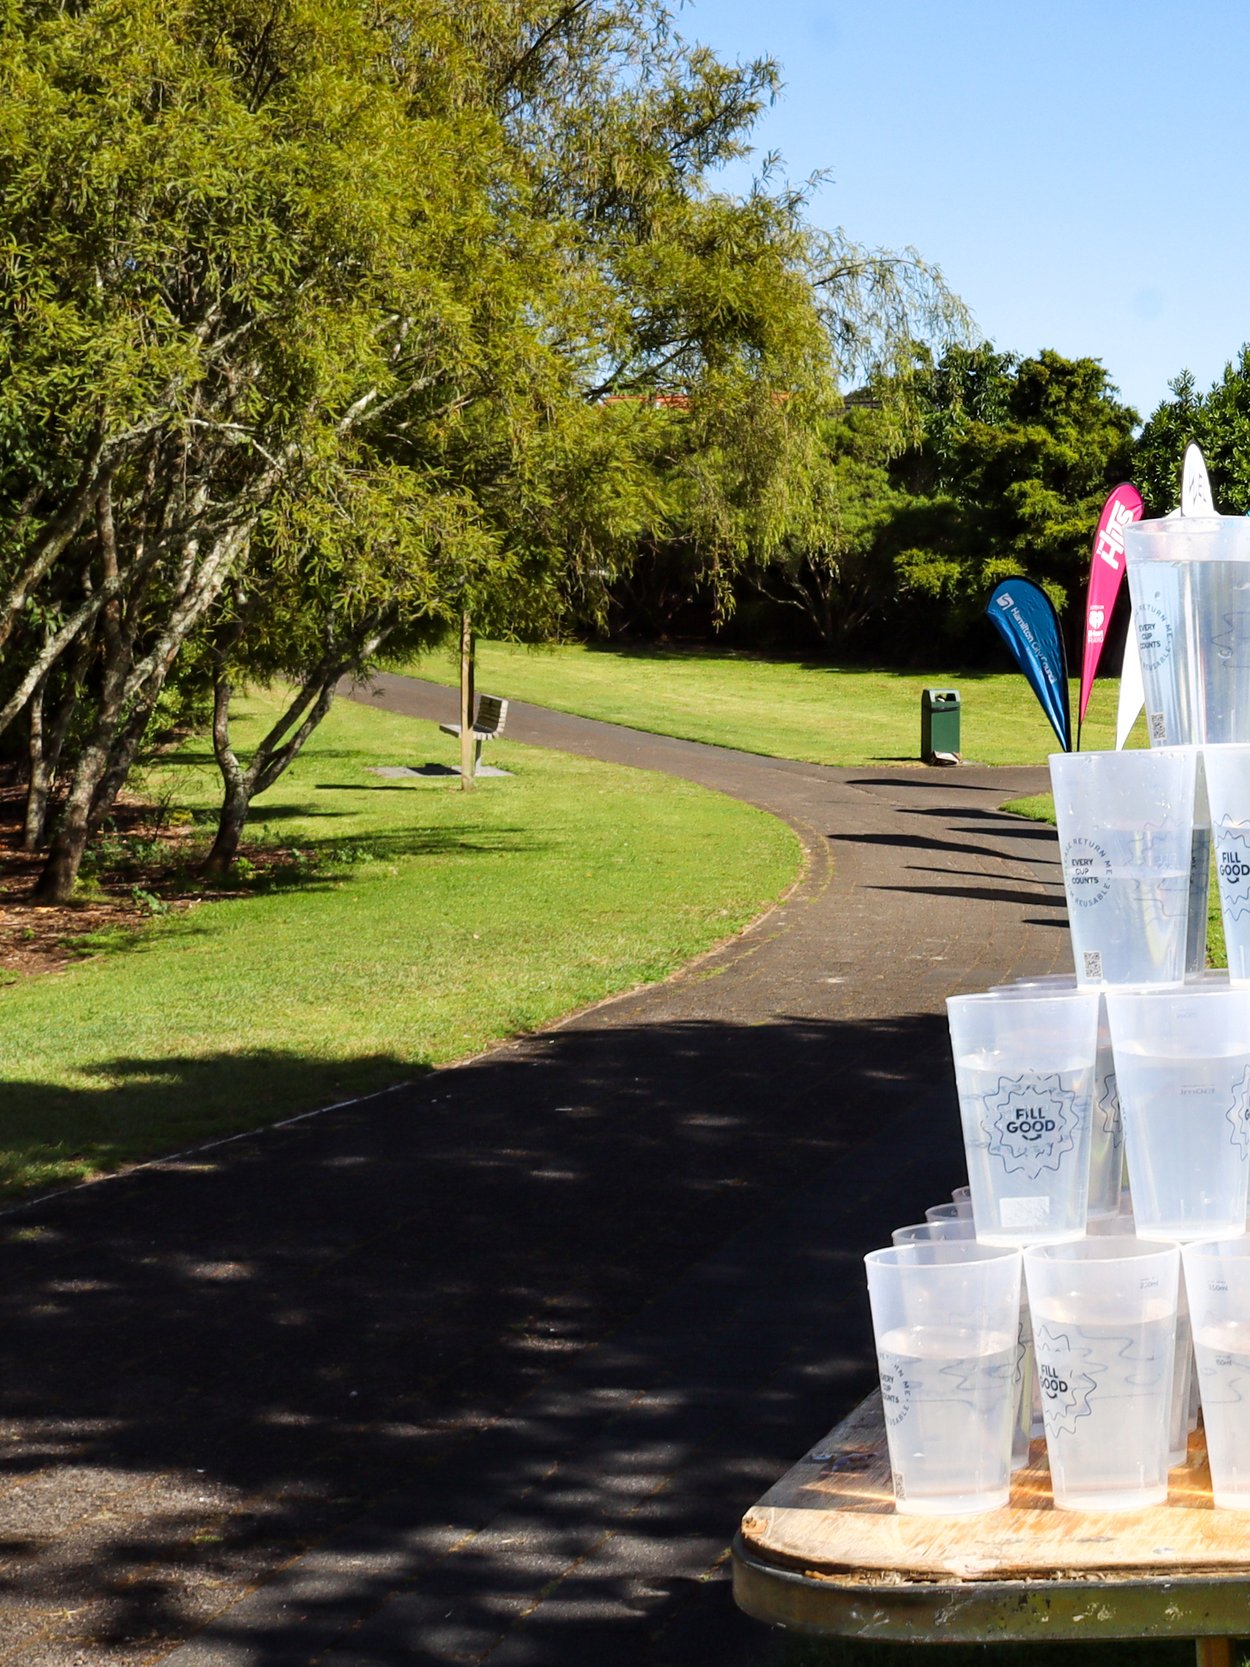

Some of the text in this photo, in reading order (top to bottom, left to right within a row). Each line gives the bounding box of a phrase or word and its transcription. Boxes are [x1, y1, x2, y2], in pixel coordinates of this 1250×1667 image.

[1010, 607, 1034, 643] Hamilton
[1073, 838, 1106, 857] RETURN
[1105, 860, 1113, 874] ME
[1222, 852, 1241, 863] FILL
[1219, 865, 1250, 876] GOOD
[1072, 877, 1099, 885] COUNTS
[1016, 1107, 1046, 1120] FILL
[1006, 1120, 1056, 1133] GOOD
[1041, 1364, 1059, 1379] FILL
[903, 1381, 911, 1396] ME
